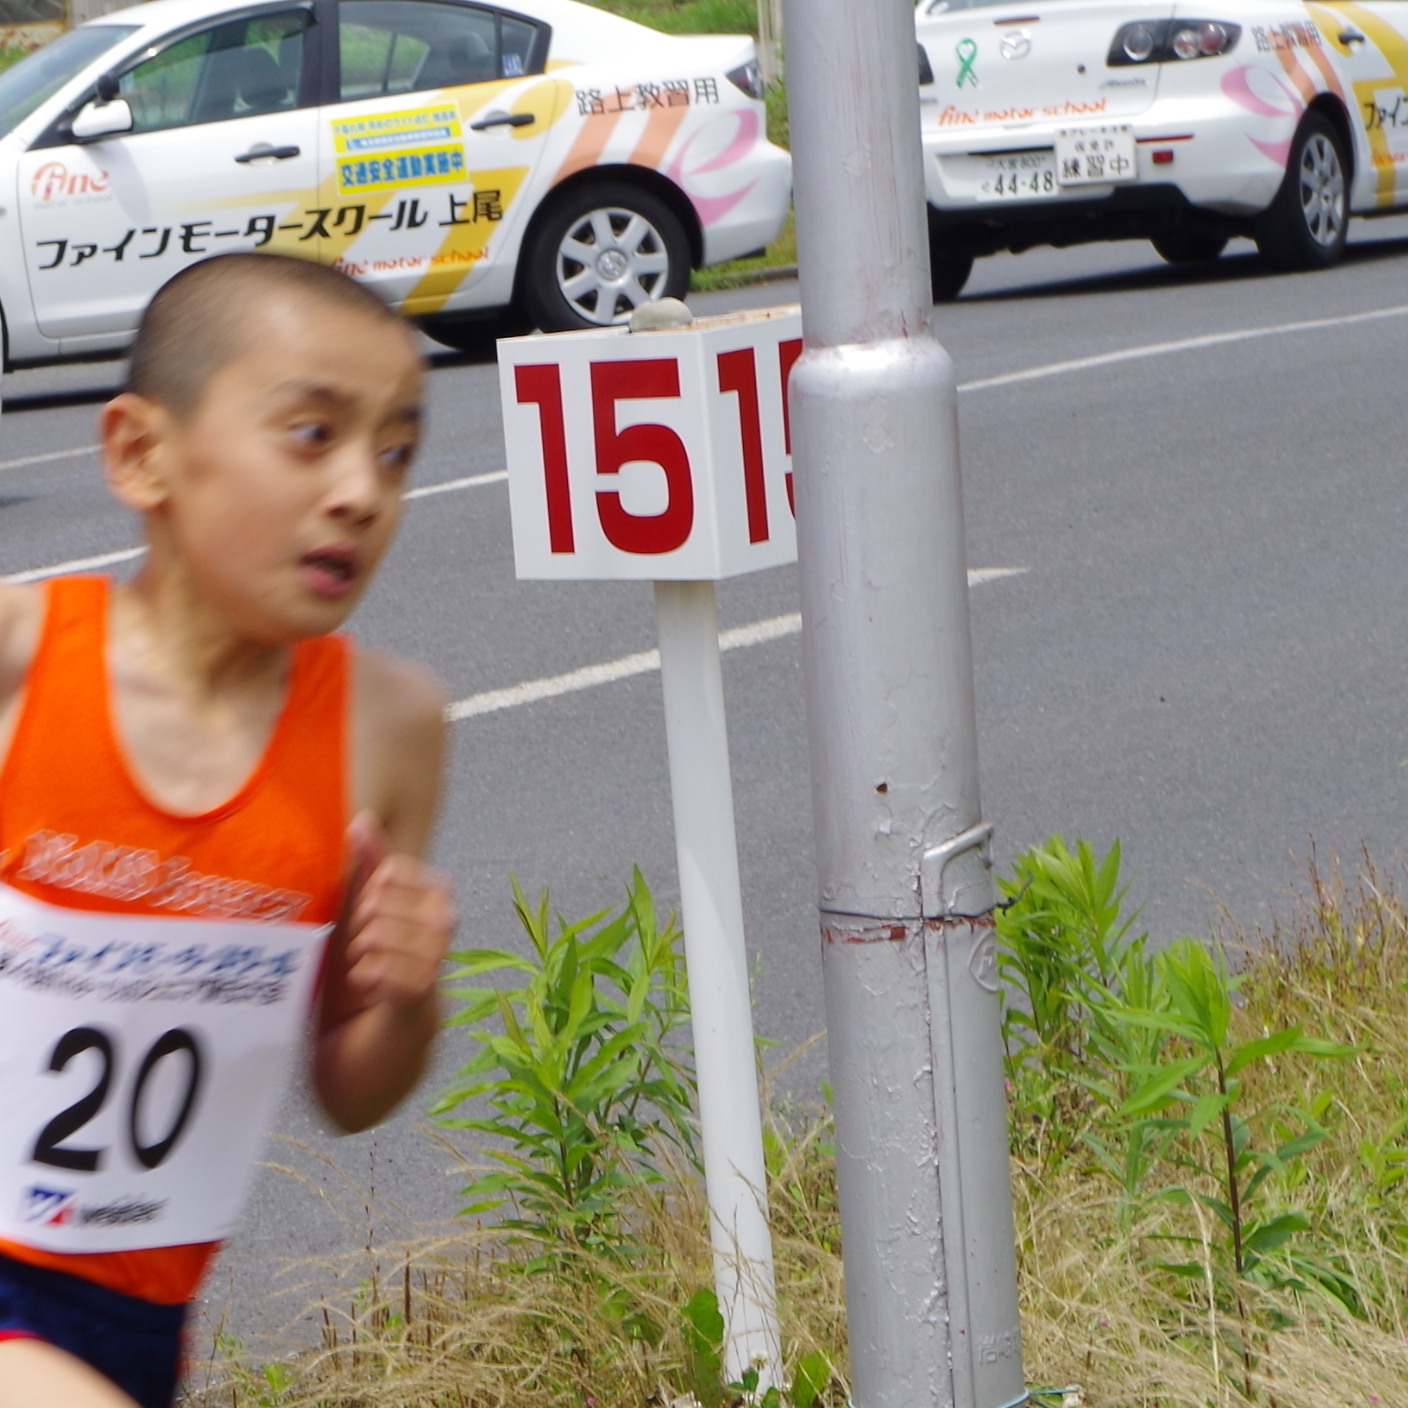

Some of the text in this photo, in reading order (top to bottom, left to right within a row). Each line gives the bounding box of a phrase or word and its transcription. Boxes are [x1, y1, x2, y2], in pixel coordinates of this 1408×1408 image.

[575, 78, 720, 116] 路上教習用
[995, 170, 1053, 196] 44-48
[36, 189, 504, 270] ファインモータースクール 上尾
[514, 358, 695, 556] 15
[30, 1025, 202, 1173] 20
